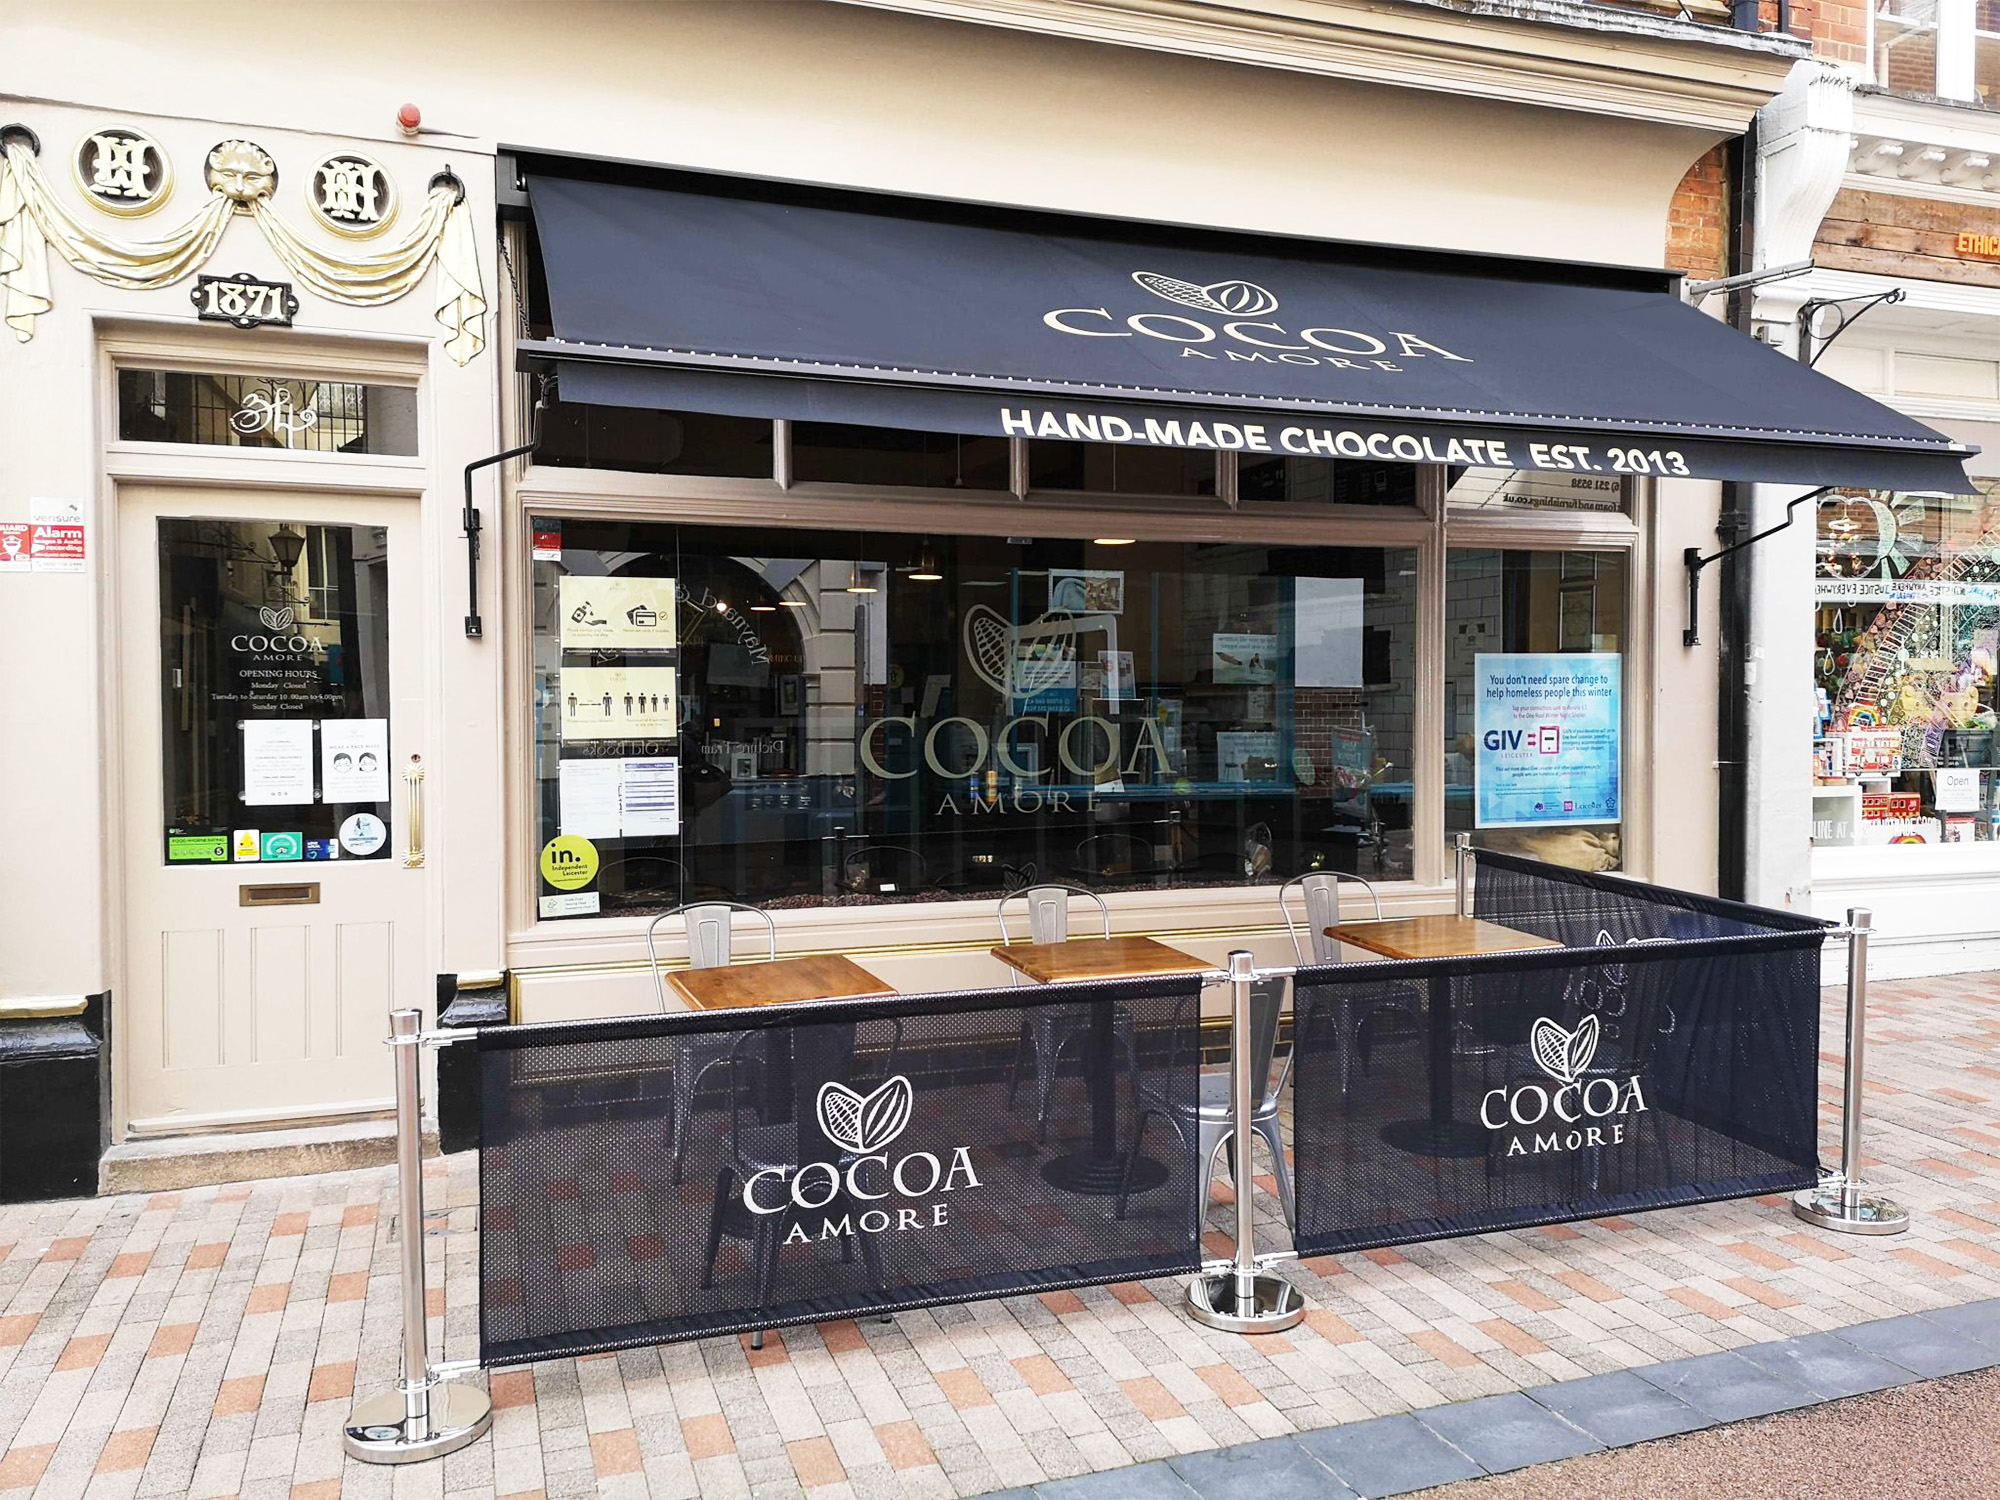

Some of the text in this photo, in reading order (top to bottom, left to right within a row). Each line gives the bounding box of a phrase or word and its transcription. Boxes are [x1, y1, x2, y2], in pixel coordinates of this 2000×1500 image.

[202, 280, 284, 320] 1871
[1043, 307, 1473, 364] COCOA
[1179, 346, 1405, 372] AMORE
[1001, 407, 1691, 476] HAND-MADE CHOCOLATE EST. 2013
[34, 515, 81, 523] verisure
[34, 526, 83, 538] Alarm
[231, 634, 326, 652] COCOA
[239, 669, 318, 678] OPENING HOURS
[1490, 674, 1608, 687] You don't need spare change to
[251, 681, 307, 691] Monday Closed
[1486, 687, 1612, 700] help homeless people this winter
[211, 693, 239, 702] Tuesday
[249, 692, 278, 701] Saturday
[252, 703, 278, 711] Sunday
[860, 711, 1177, 779] COCOA
[1947, 775, 1969, 787] Open
[935, 790, 1102, 816] AMORE
[551, 843, 581, 864] in.
[552, 864, 588, 872] Independent
[1480, 1075, 1649, 1130] COCOA
[1507, 1124, 1625, 1157] AMORE
[743, 1146, 984, 1214] COCOA
[783, 1203, 951, 1245] AMORE
